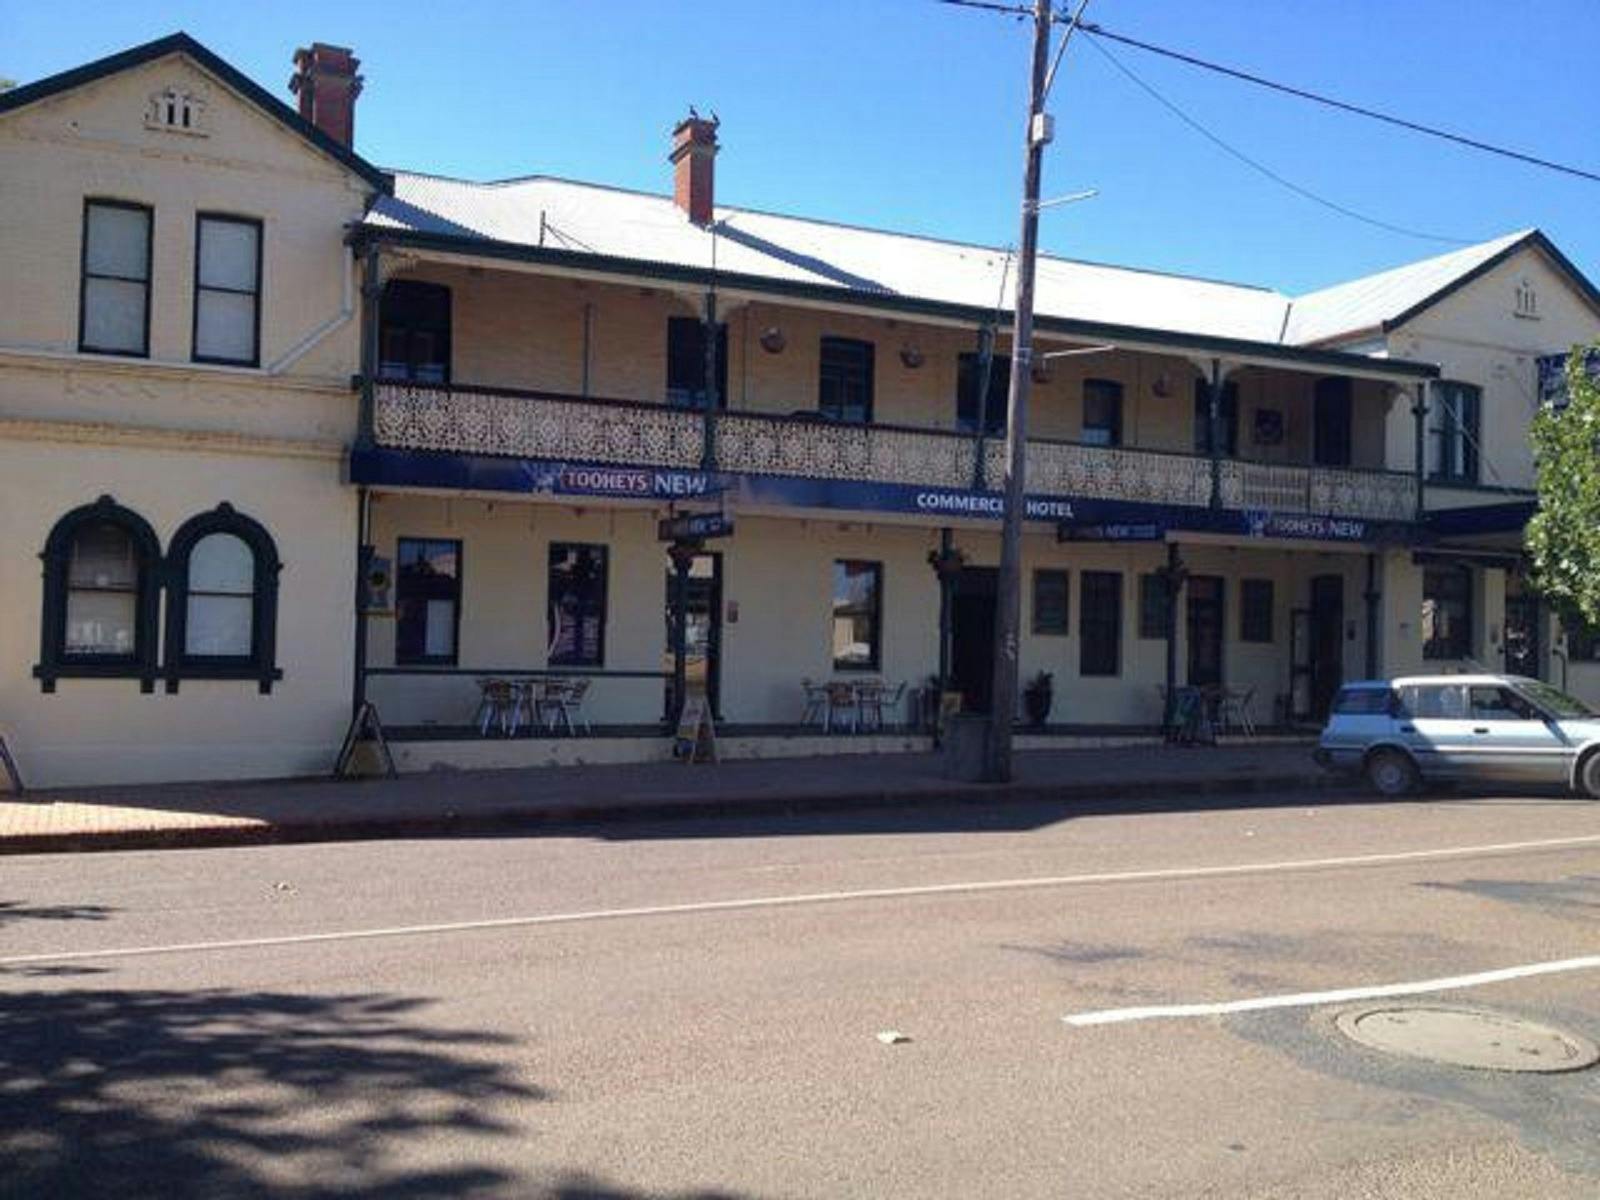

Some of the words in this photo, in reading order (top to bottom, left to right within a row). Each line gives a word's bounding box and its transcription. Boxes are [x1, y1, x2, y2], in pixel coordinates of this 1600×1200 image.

[567, 472, 647, 491] TOOHEYS
[653, 474, 706, 494] NEW
[916, 493, 1003, 512] COMMERCI
[1026, 501, 1073, 518] HOTEL
[1329, 520, 1364, 539] NEW
